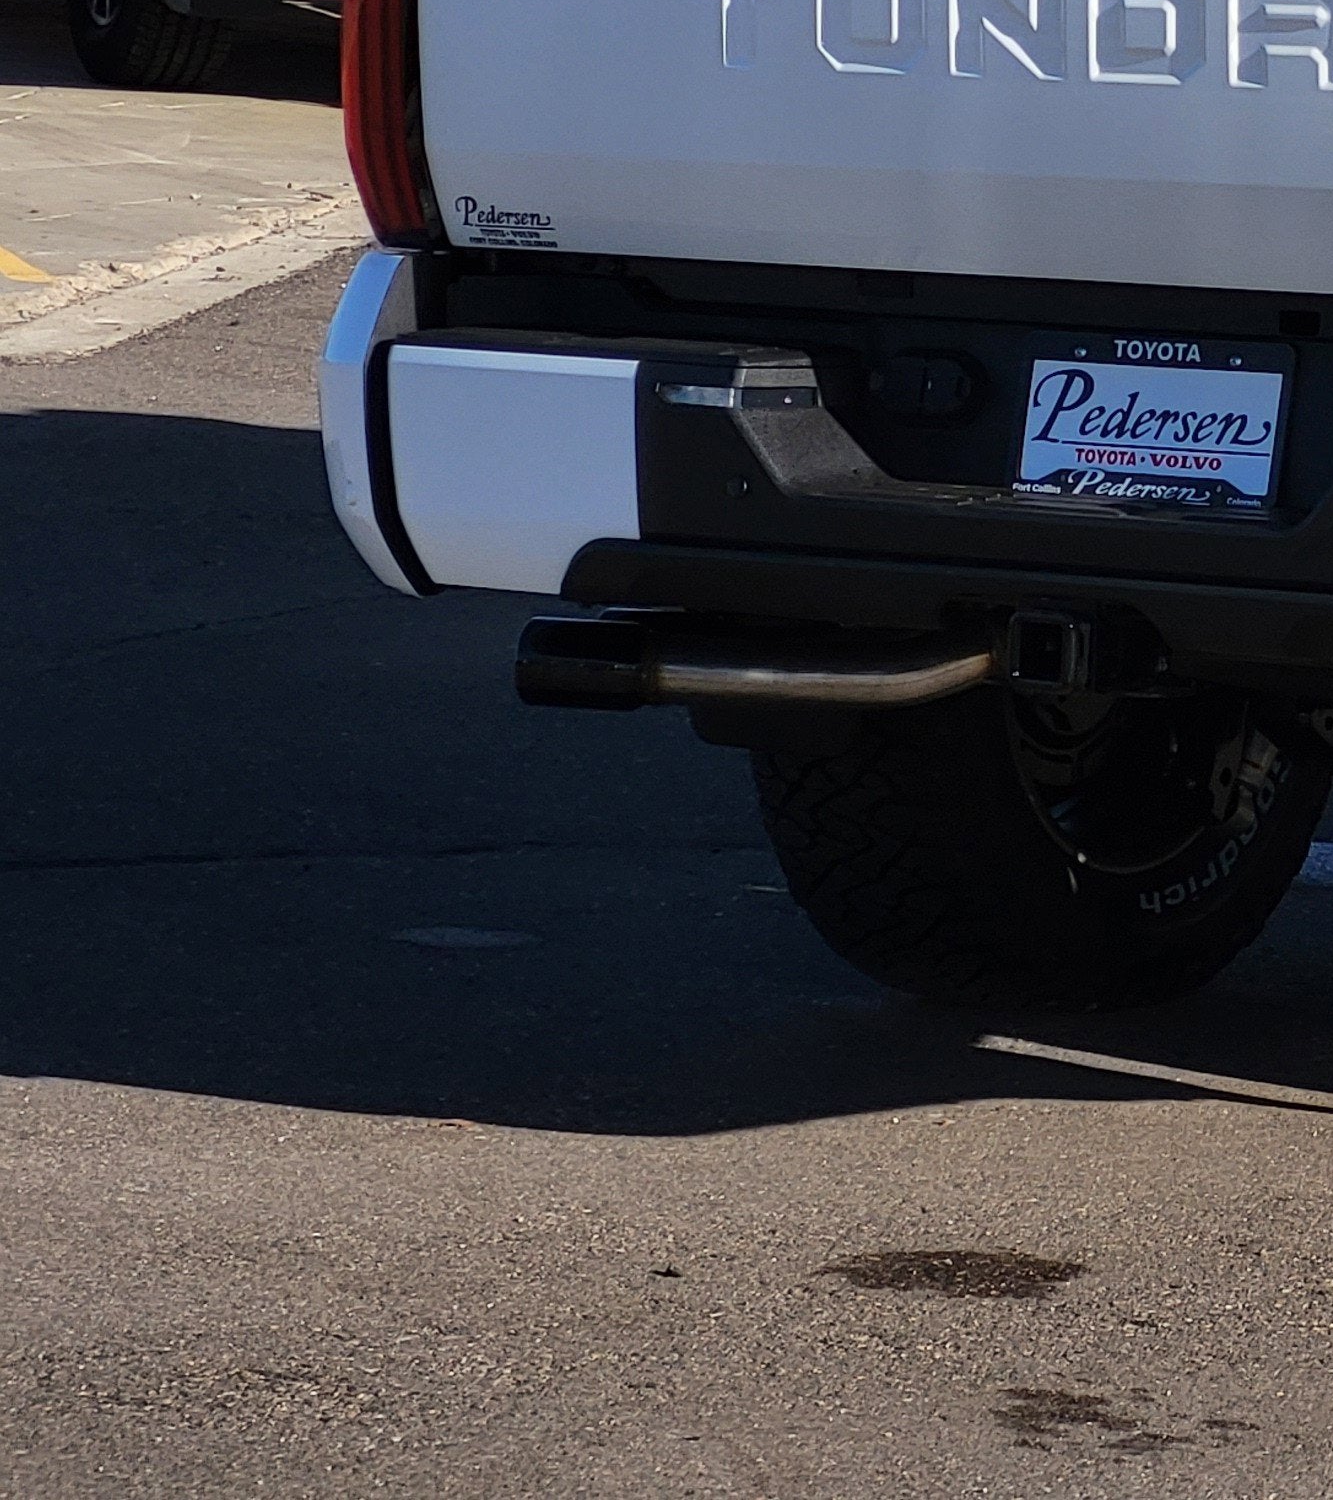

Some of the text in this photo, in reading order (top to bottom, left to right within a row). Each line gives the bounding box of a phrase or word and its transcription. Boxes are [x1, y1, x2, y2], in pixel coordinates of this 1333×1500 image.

[455, 195, 551, 227] Pedersen
[1114, 339, 1201, 362] TOYOTA
[1031, 369, 1272, 446] Pedersen
[1075, 449, 1222, 471] TOYOTA VOLVO
[1067, 468, 1211, 501] Pedersen
